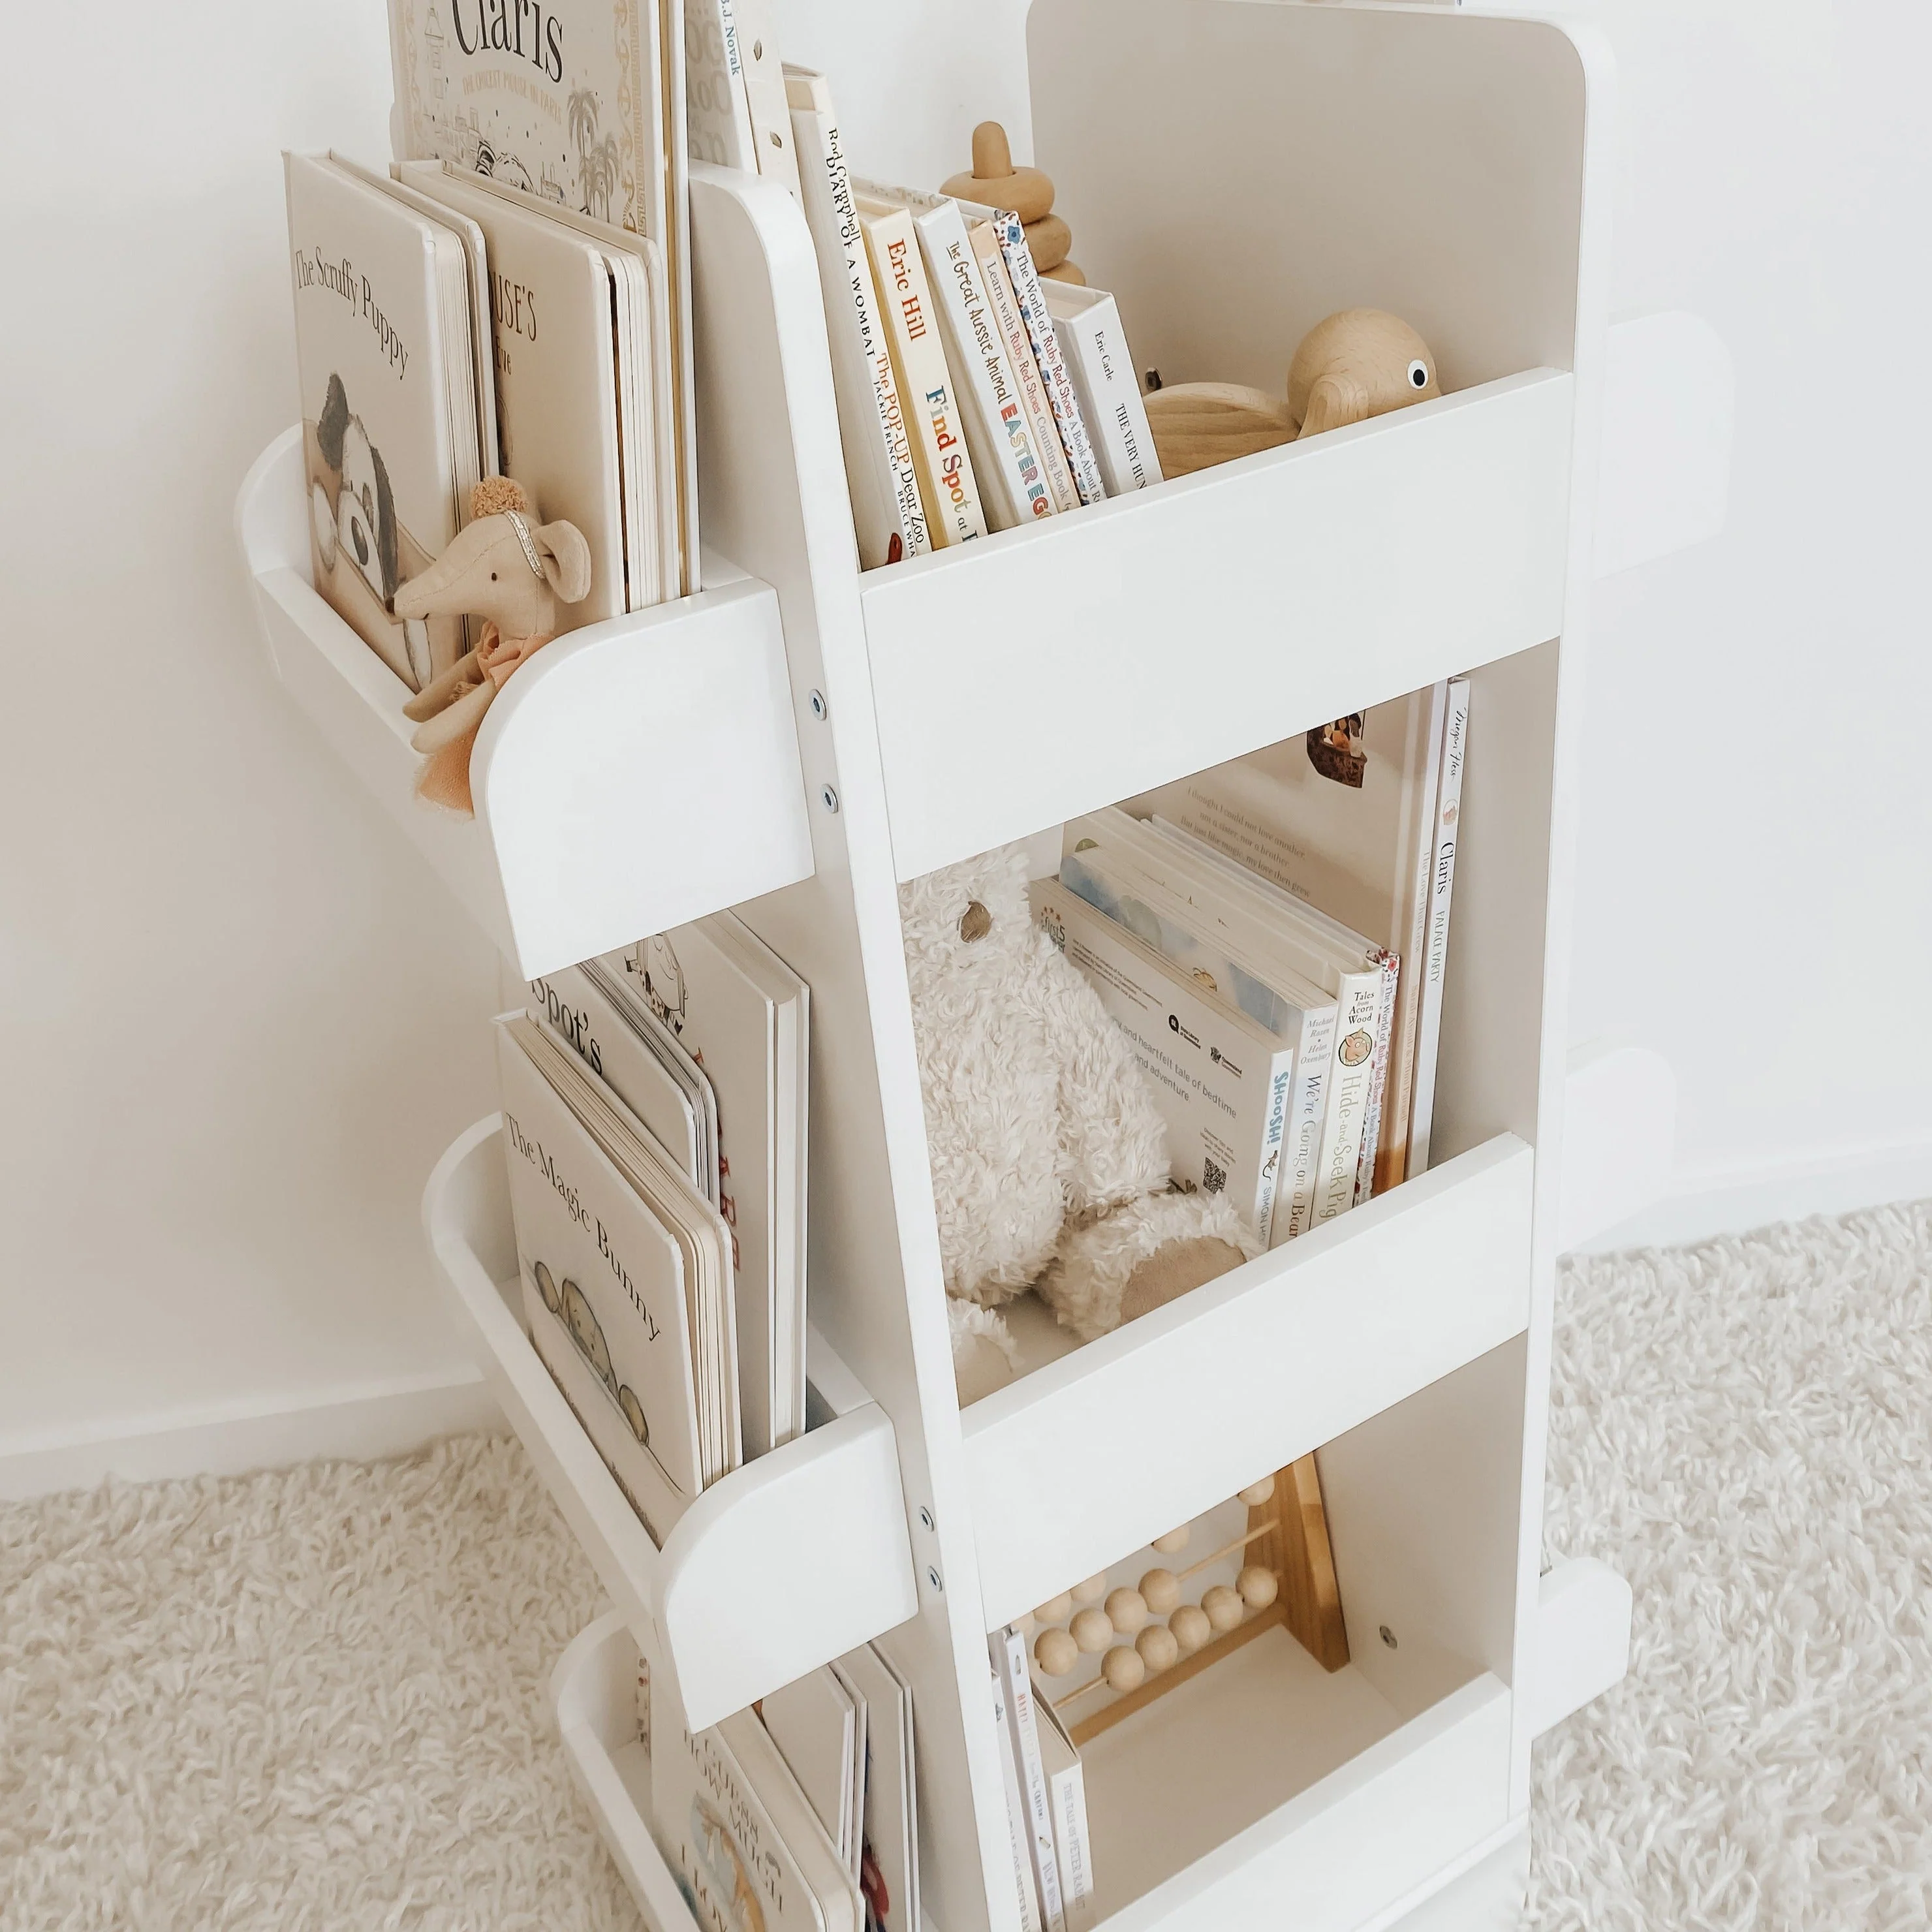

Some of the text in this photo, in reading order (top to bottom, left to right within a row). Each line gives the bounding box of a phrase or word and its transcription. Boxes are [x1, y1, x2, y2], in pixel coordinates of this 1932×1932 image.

[453, 0, 563, 83] Claris
[725, 25, 741, 76] Novak
[826, 157, 875, 356] DIARY OF A WOMBAT
[1017, 251, 1031, 279] The
[888, 238, 926, 341] Eric Hill
[1025, 279, 1042, 319] World
[296, 246, 408, 381] The Scruffy Puppy
[949, 240, 1012, 404] The Great Aussie Animal
[1037, 319, 1050, 333] of
[1043, 334, 1057, 365] Ruby
[1095, 330, 1114, 382] Eric Carle
[987, 260, 1004, 301] Learn
[999, 302, 1014, 332] with
[1010, 331, 1024, 360] Ruby
[1020, 360, 1034, 384] Red
[1027, 382, 1040, 414] Shoes
[1036, 416, 1057, 471] Counting
[1053, 471, 1069, 501] Book
[1052, 364, 1065, 387] Red
[1059, 387, 1074, 418] Shoes
[873, 381, 898, 471] JACKIE FRENCH
[1068, 420, 1078, 429] A
[1115, 403, 1125, 431] THE
[1123, 429, 1140, 463] VERY
[877, 352, 924, 543] The POP-UP Dear Zoo
[926, 385, 958, 452] Find
[942, 454, 971, 514] Spot
[958, 517, 968, 531] at
[1001, 403, 1038, 486] EASTER
[1072, 429, 1087, 460] Book
[1081, 459, 1097, 490] About
[897, 490, 910, 527] BRUCE
[1430, 842, 1454, 982] Claris PALACE PARTY
[1349, 1005, 1373, 1014] Acorn
[1354, 991, 1375, 1001] Tales
[1384, 984, 1393, 1003] The
[532, 978, 602, 1076] Spot's
[1307, 1016, 1334, 1029] Michael
[1310, 1027, 1330, 1038] Rosen
[1348, 1013, 1372, 1024] Wood
[1380, 1004, 1390, 1031] World
[1134, 1053, 1149, 1068] and
[1300, 1052, 1331, 1065] Oxenbury
[1308, 1043, 1327, 1053] Helen
[1123, 1026, 1137, 1040] and
[1138, 1035, 1172, 1068] heartfelt
[1175, 1064, 1190, 1082] tale
[1192, 1079, 1201, 1089] of
[1202, 1084, 1237, 1119] bedtime
[1304, 1074, 1322, 1114] We're
[1293, 1120, 1315, 1166] Going
[1296, 1170, 1306, 1187] on
[1260, 1187, 1271, 1224] SIMON
[1289, 1204, 1305, 1238] Bear
[1319, 1192, 1347, 1219] Pig
[506, 1112, 661, 1341] The Magic Bunny
